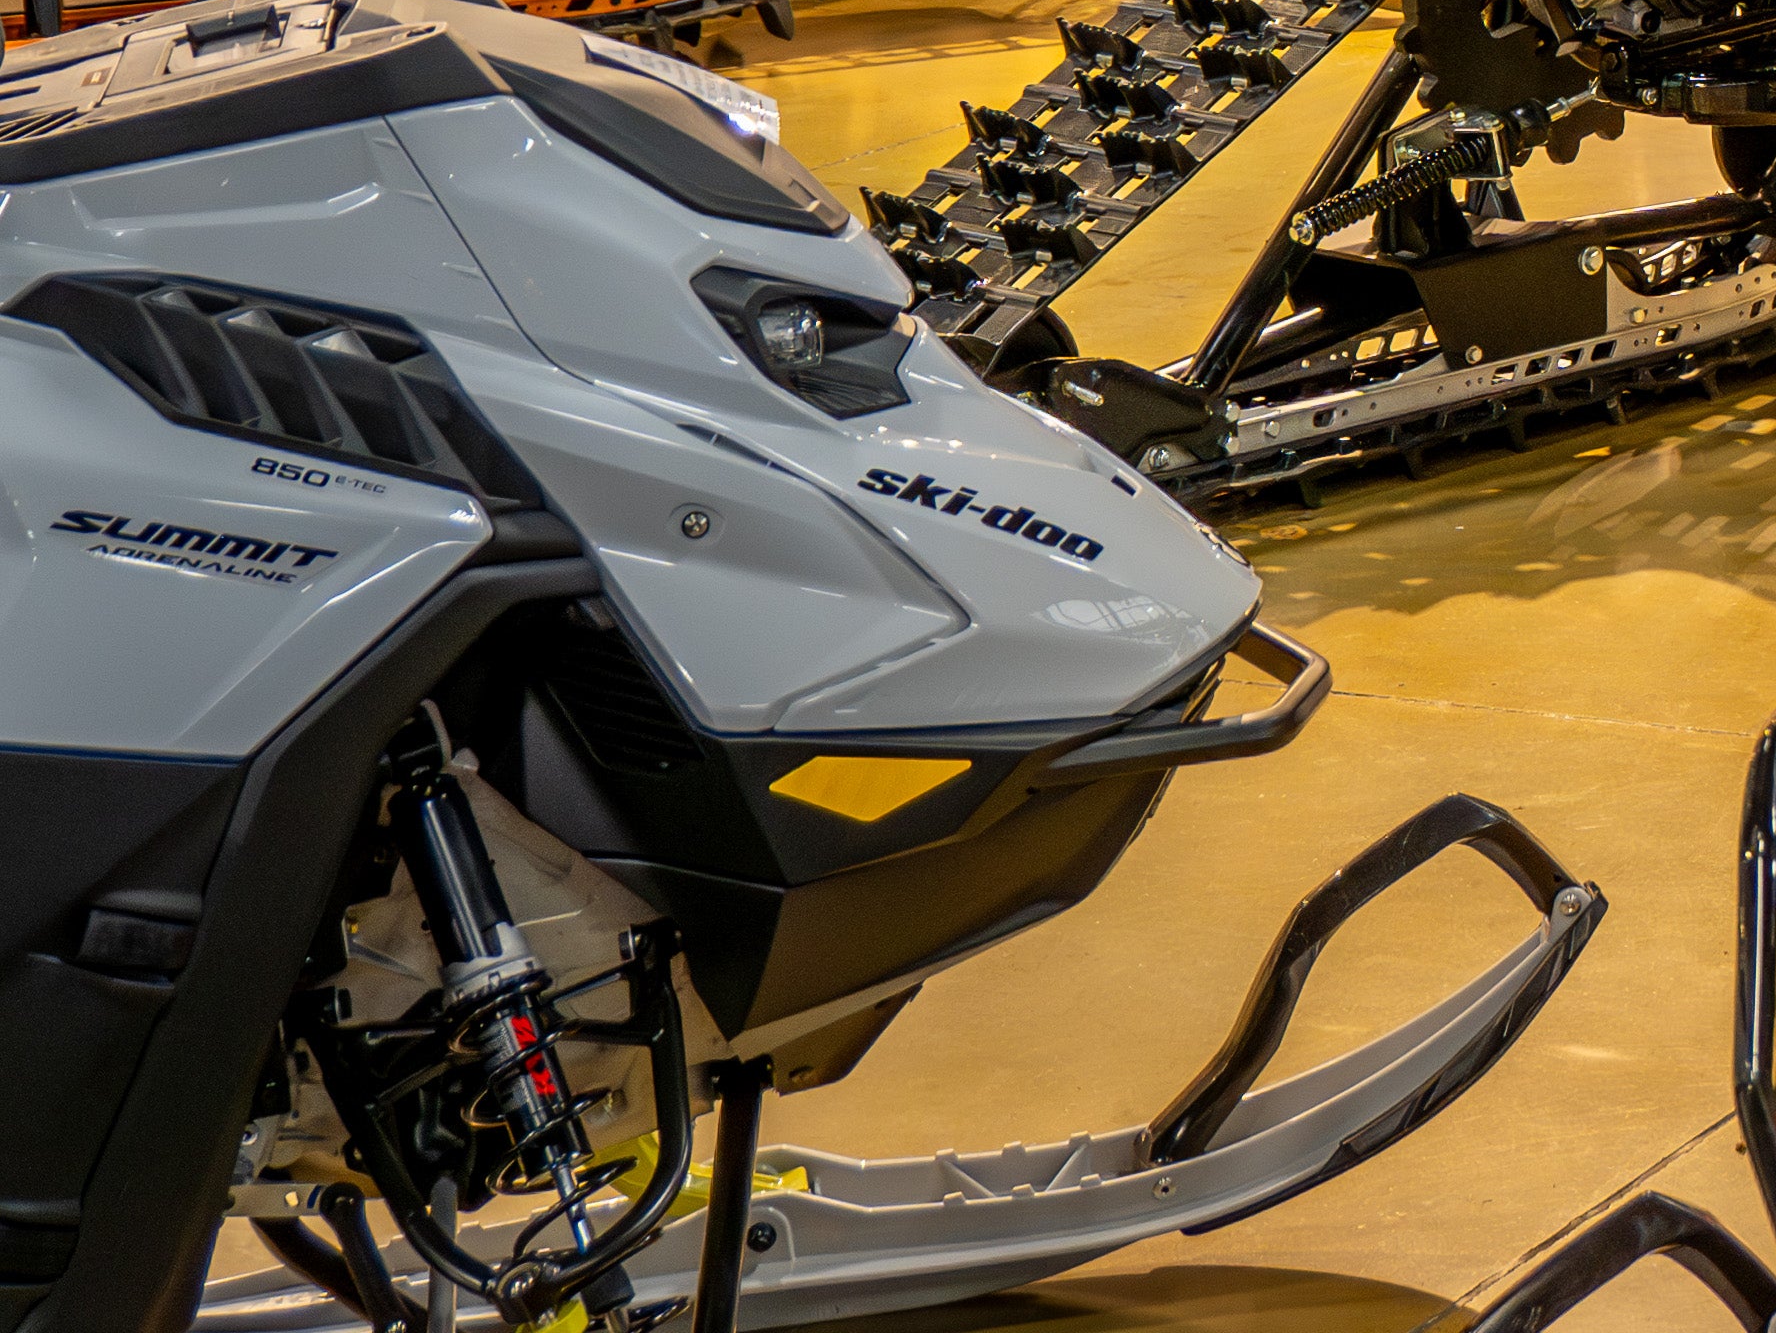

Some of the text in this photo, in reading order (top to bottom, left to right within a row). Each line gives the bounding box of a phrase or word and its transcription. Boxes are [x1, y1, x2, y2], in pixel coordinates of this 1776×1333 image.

[250, 456, 387, 495] 850 E-TEC
[50, 509, 340, 568] SUMMIT
[857, 467, 1105, 562] ski-doo
[85, 543, 299, 584] ADRENALINE
